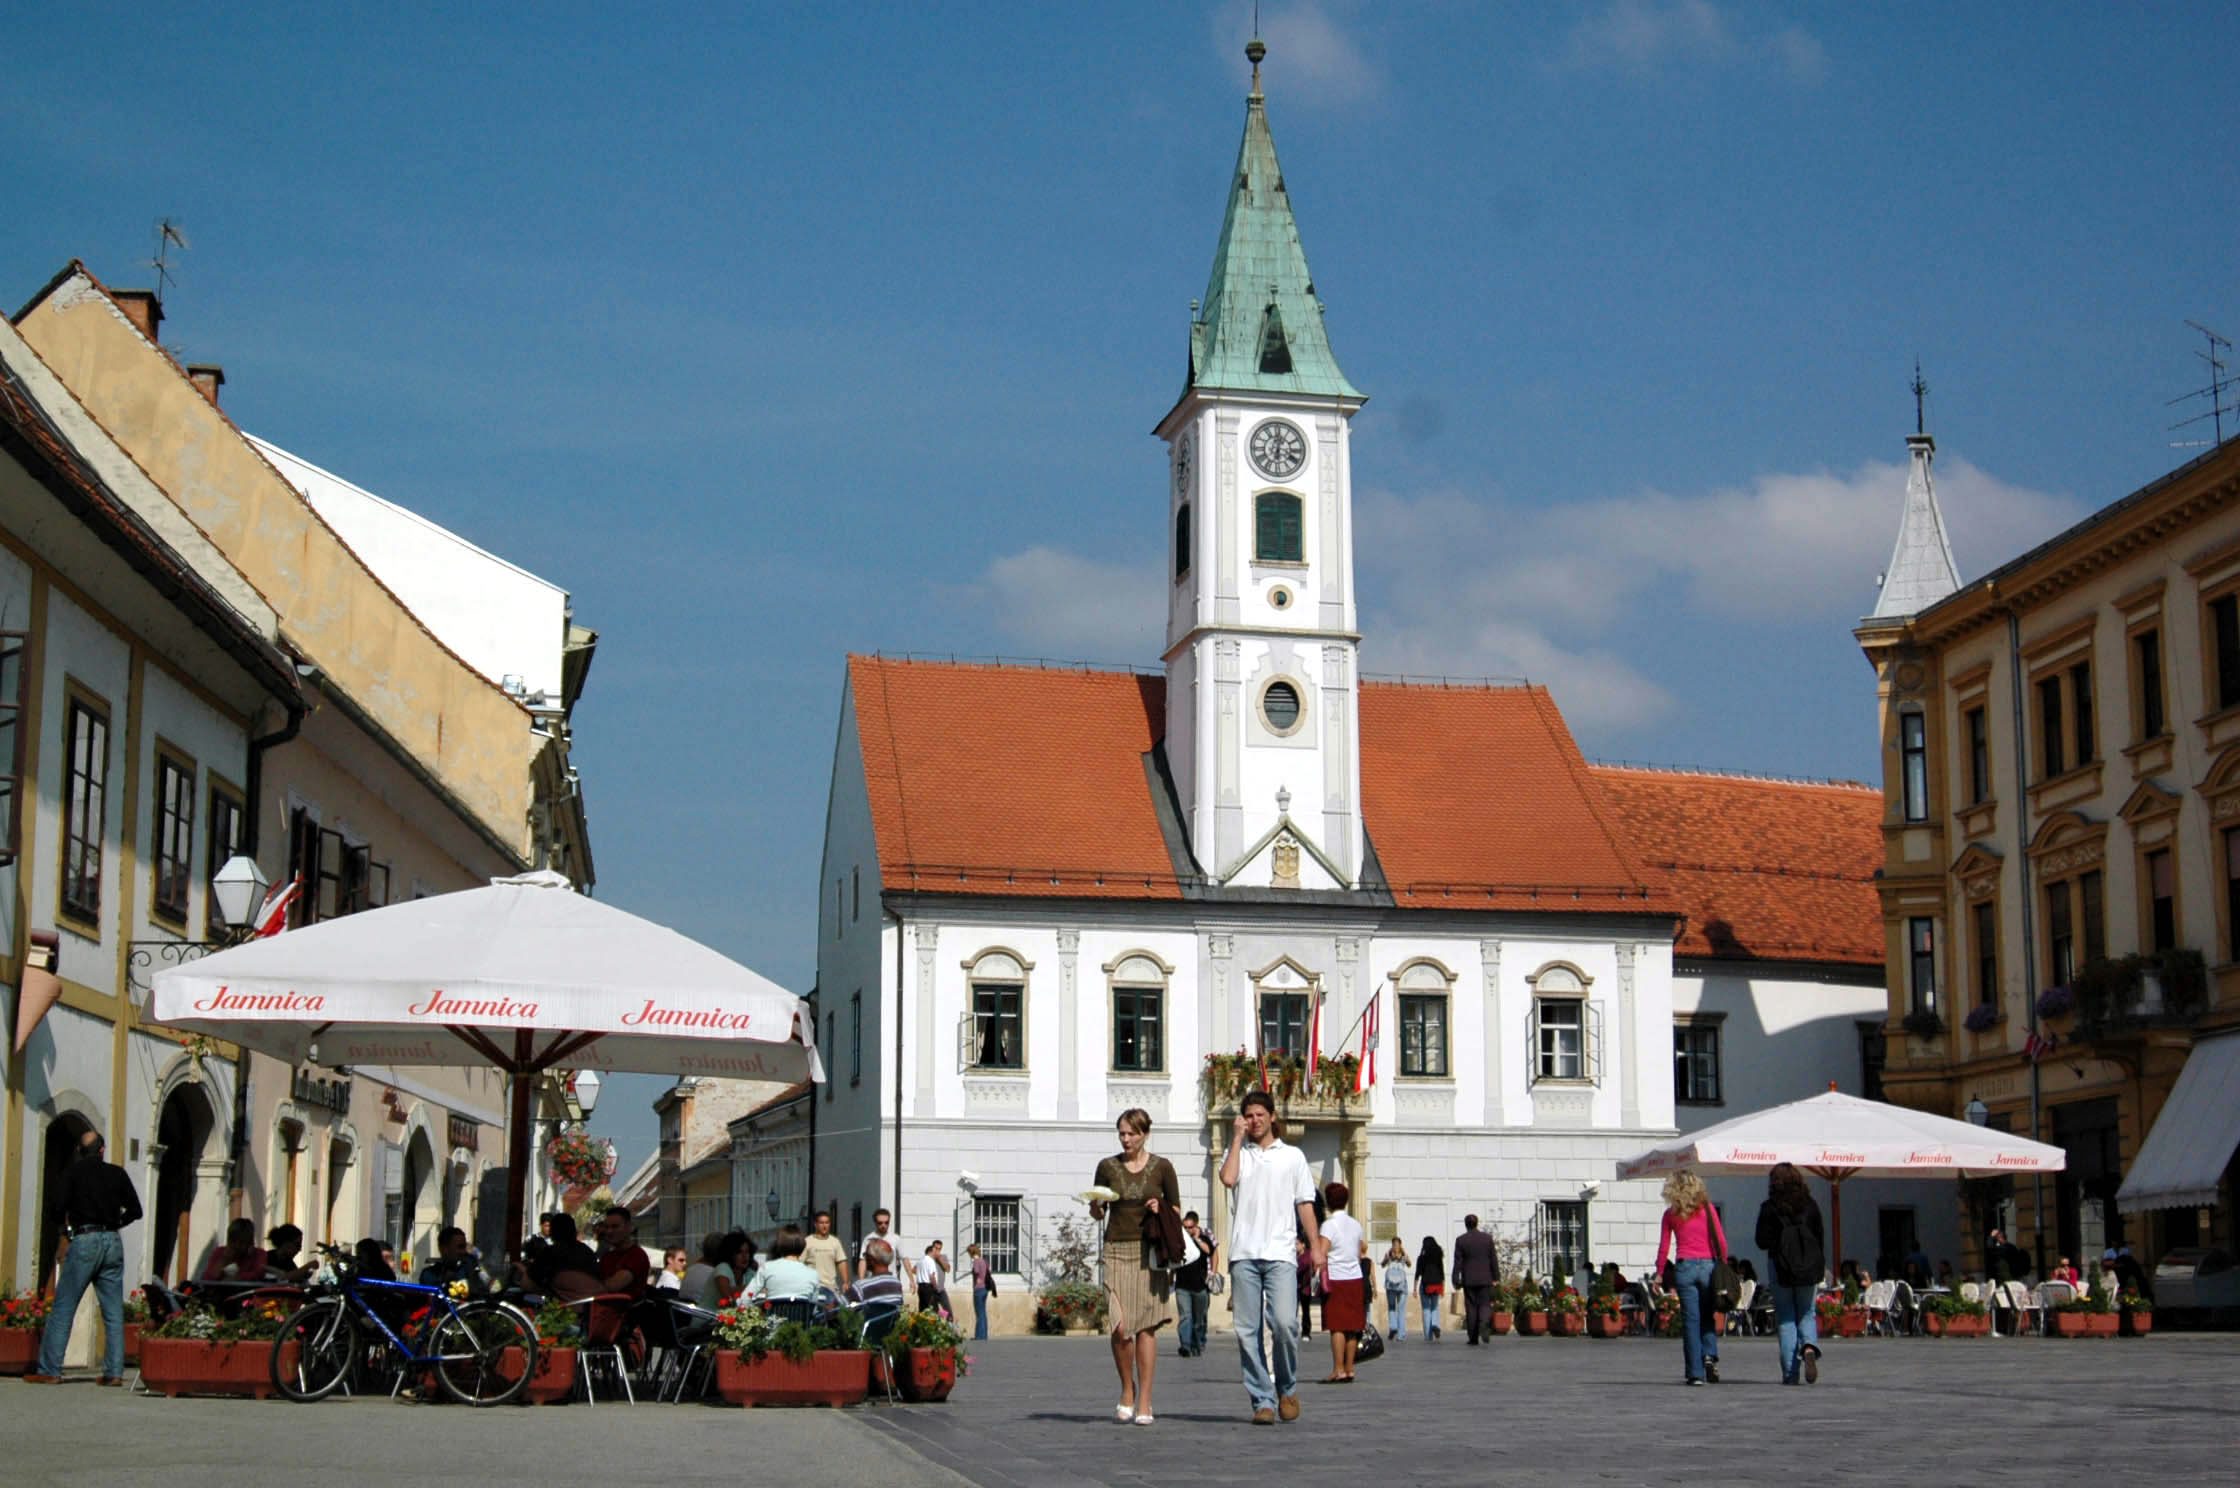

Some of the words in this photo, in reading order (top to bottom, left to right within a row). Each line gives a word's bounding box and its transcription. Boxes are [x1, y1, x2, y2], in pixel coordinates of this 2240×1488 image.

[193, 984, 325, 1012] Jamnica
[408, 990, 539, 1018] Jamnica
[621, 999, 751, 1029] Jamnica
[1727, 1149, 1777, 1161] Jamnica
[1816, 1150, 1866, 1163] Jamnica
[1904, 1151, 1953, 1164] Jamnica
[1990, 1153, 2039, 1166] Jamnica
